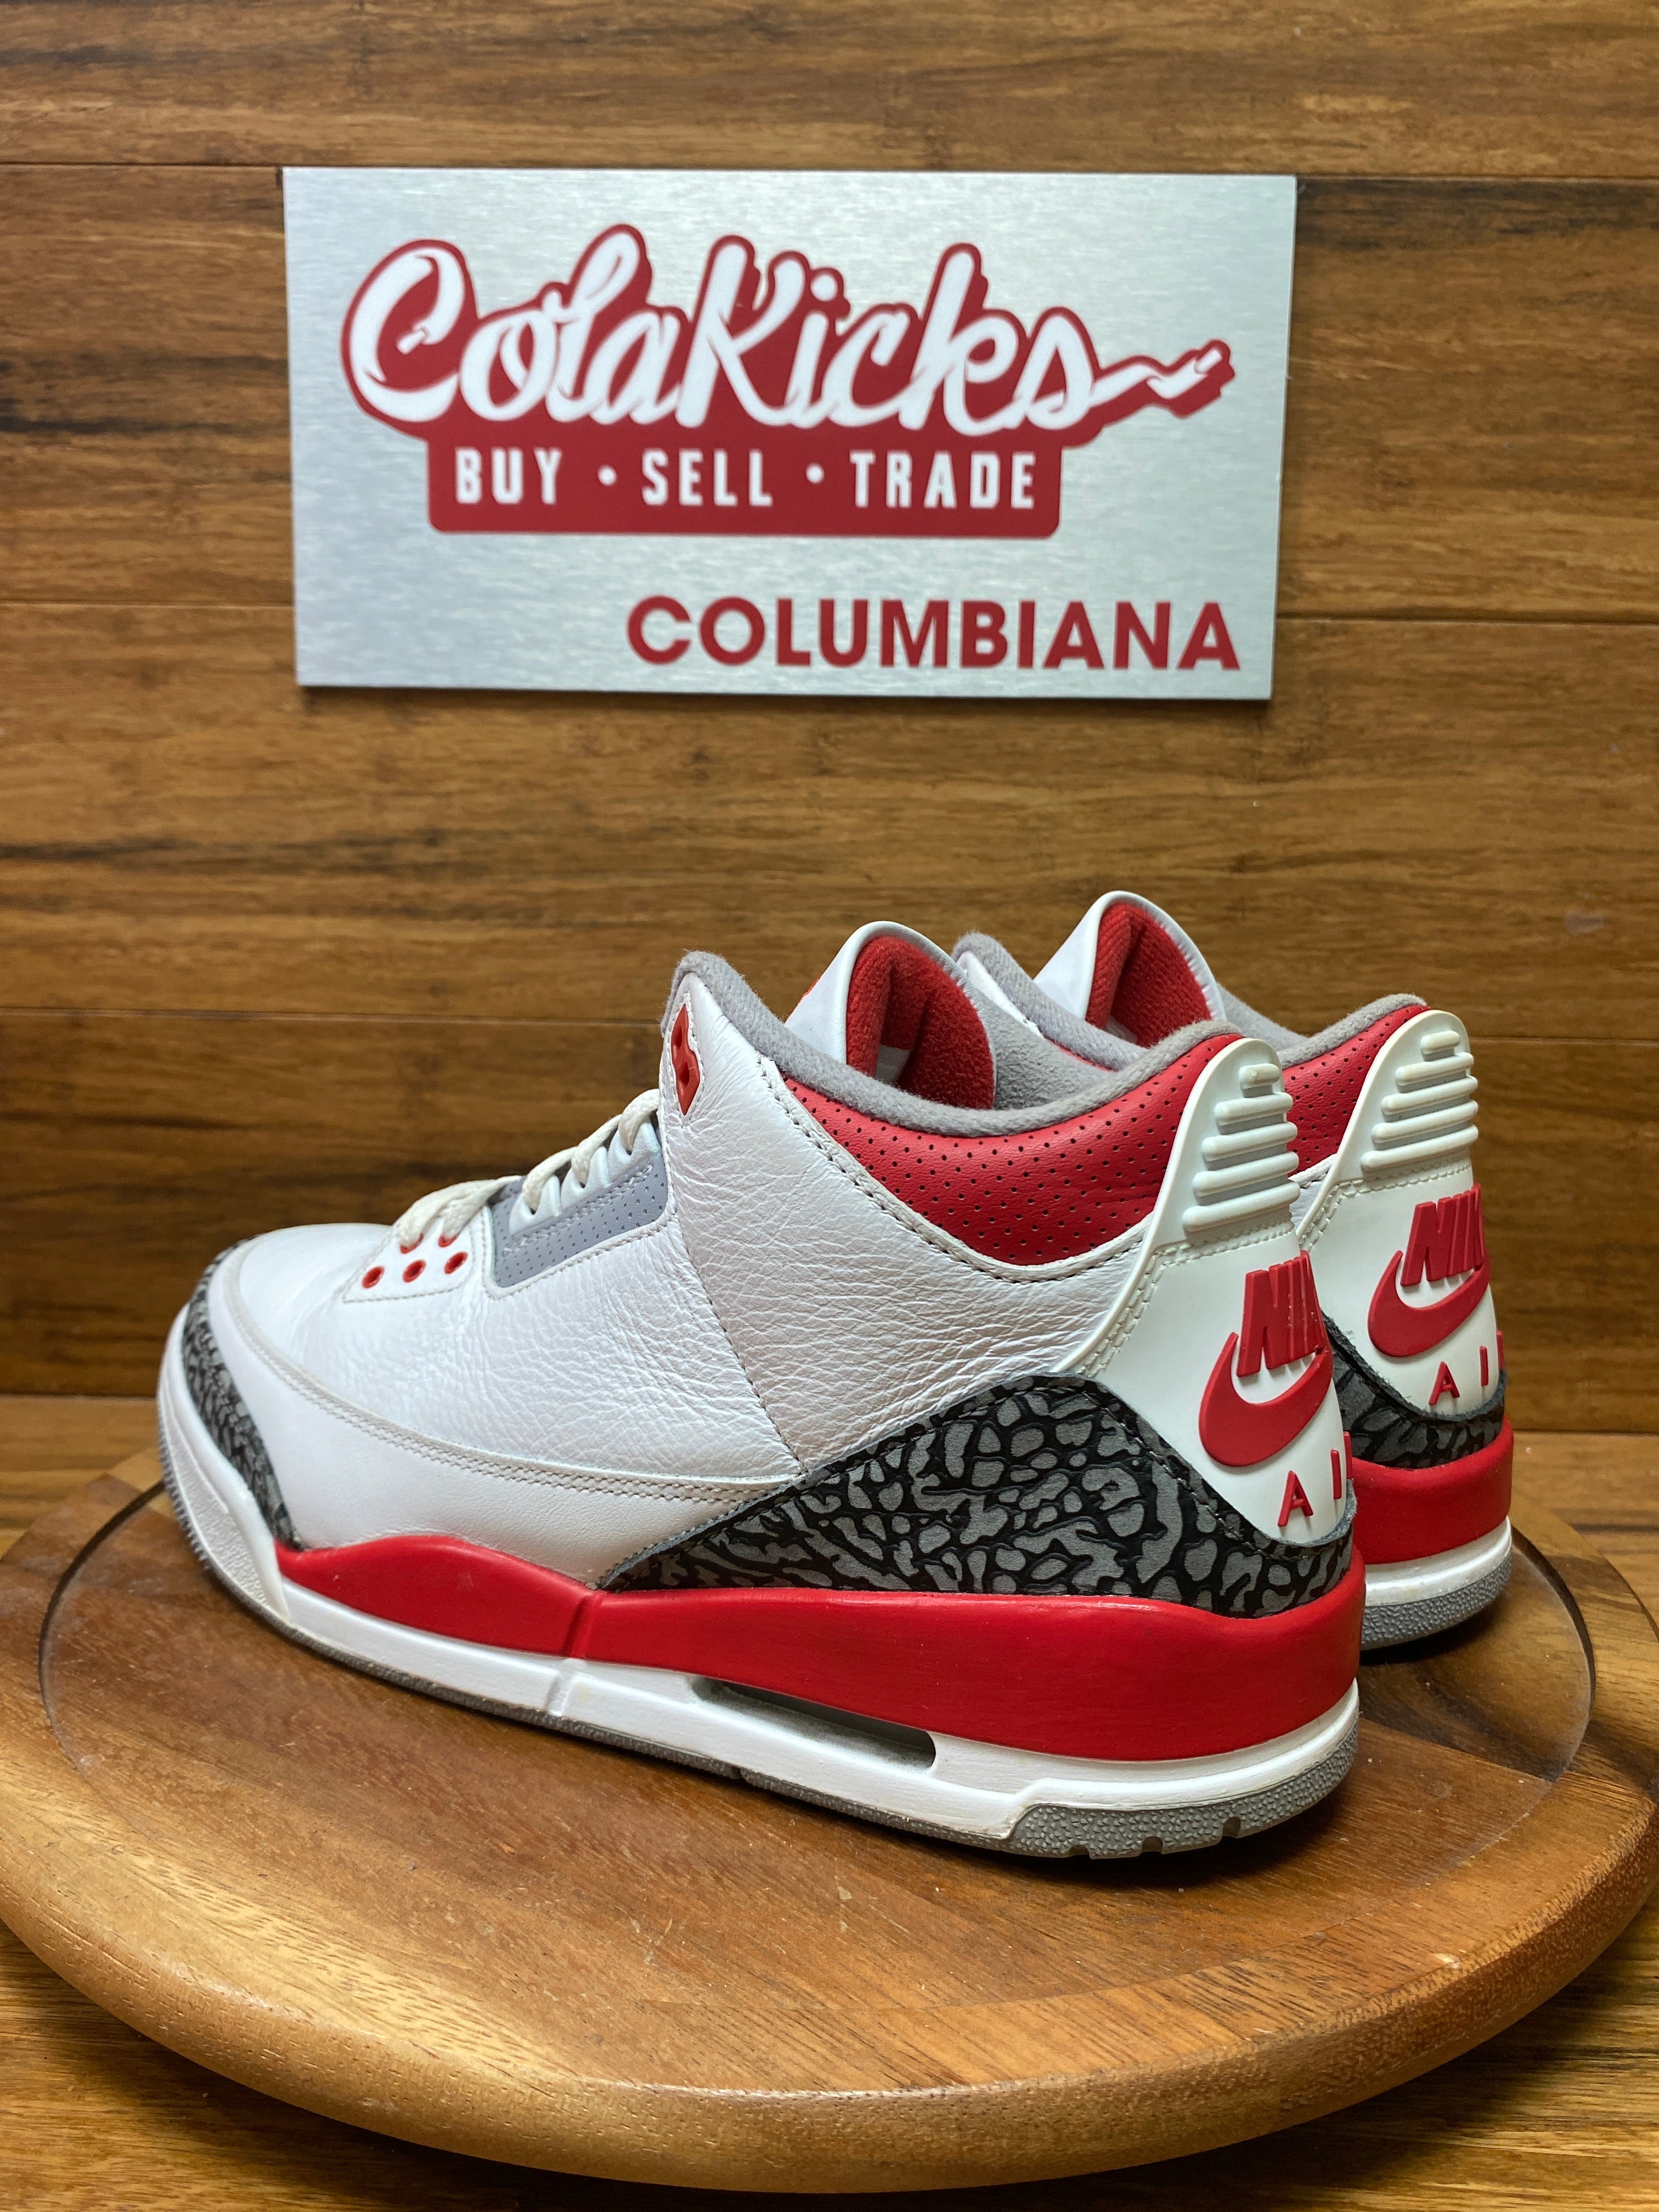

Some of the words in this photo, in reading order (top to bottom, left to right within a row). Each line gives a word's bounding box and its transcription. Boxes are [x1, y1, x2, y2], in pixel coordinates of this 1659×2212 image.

[348, 230, 1223, 437] ColaKicks
[454, 448, 562, 505] BUY
[642, 448, 773, 507] SELL
[849, 450, 1036, 509] TRADE
[627, 595, 1241, 670] COLUMBIANA
